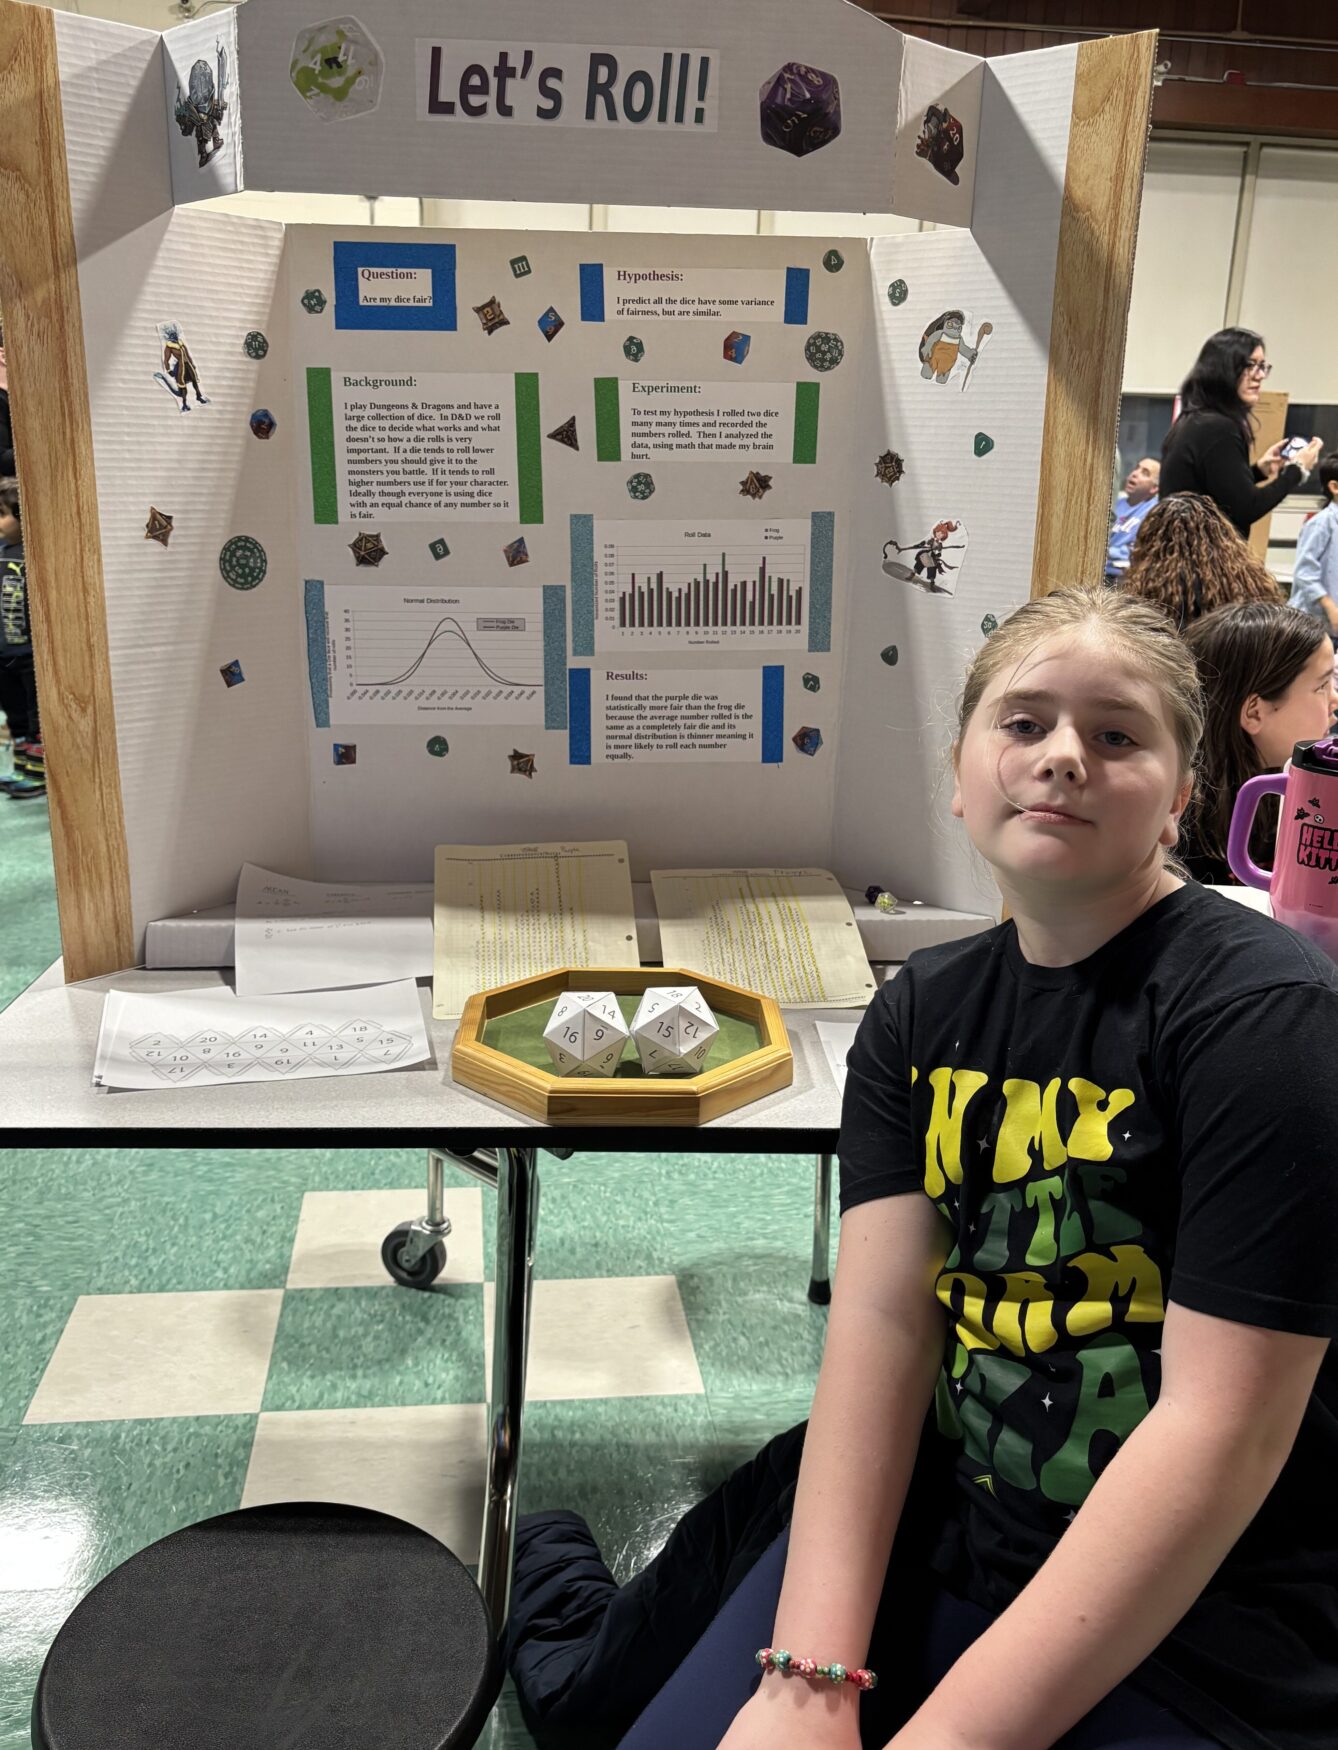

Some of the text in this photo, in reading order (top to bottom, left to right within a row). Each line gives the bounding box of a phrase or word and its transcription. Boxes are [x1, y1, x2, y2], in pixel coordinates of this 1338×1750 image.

[428, 46, 711, 125] Let’s Roll!
[361, 269, 417, 281] Question:
[617, 270, 683, 284] Hypothesis:
[362, 295, 432, 306] Are my dice fair?
[617, 297, 620, 305] I
[623, 297, 651, 308] predict
[653, 297, 663, 305] all
[665, 297, 678, 305] the
[680, 297, 696, 306] dice
[698, 297, 716, 306] have
[741, 298, 775, 306] variance
[617, 307, 625, 316] of
[627, 308, 660, 317] fairness,
[662, 308, 675, 316] but
[692, 308, 722, 316] similar.
[344, 376, 416, 389] Background:
[632, 383, 701, 396] Experiment:
[344, 402, 348, 410] I
[350, 402, 367, 412] play
[370, 402, 409, 412] Dungeons
[411, 402, 418, 410] &
[421, 402, 455, 412] Dragons
[457, 402, 472, 410] and
[474, 402, 492, 410] have
[345, 413, 366, 423] large
[367, 413, 405, 421] collection
[407, 413, 415, 421] of
[417, 413, 436, 421] dice.
[440, 413, 449, 421] In
[451, 413, 472, 421] D&D
[487, 413, 501, 421] roll
[631, 409, 642, 417] To
[644, 409, 657, 417] test
[660, 410, 672, 419] my
[674, 409, 714, 420] hypothesis
[717, 409, 720, 417] I
[723, 409, 745, 417] rolled
[763, 410, 779, 418] dice
[632, 420, 768, 430] many many times and recorded the
[455, 437, 472, 445] very
[632, 431, 773, 441] numbers rolled. Then I analyzed the
[347, 446, 389, 456] important.
[394, 446, 400, 454] If
[409, 446, 422, 454] die
[424, 446, 445, 454] tends
[447, 446, 455, 454] to
[457, 446, 470, 454] roll
[472, 446, 495, 454] lower
[631, 442, 774, 452] data, using math that made my brain
[631, 452, 651, 460] hurt.
[606, 671, 648, 681] Results:
[665, 693, 690, 703] purple
[691, 693, 703, 701] die
[606, 703, 647, 713] statistically
[717, 703, 732, 712] frog
[650, 714, 678, 722] average
[734, 712, 740, 720] is
[742, 712, 753, 720] the
[557, 1006, 568, 1017] 8
[601, 1004, 617, 1020] 14
[656, 1021, 674, 1038] 15
[252, 1032, 268, 1040] 14
[562, 1026, 580, 1044] 16
[378, 1037, 395, 1045] 15
[328, 1043, 343, 1051] 13
[912, 1066, 1136, 1198] N MY
